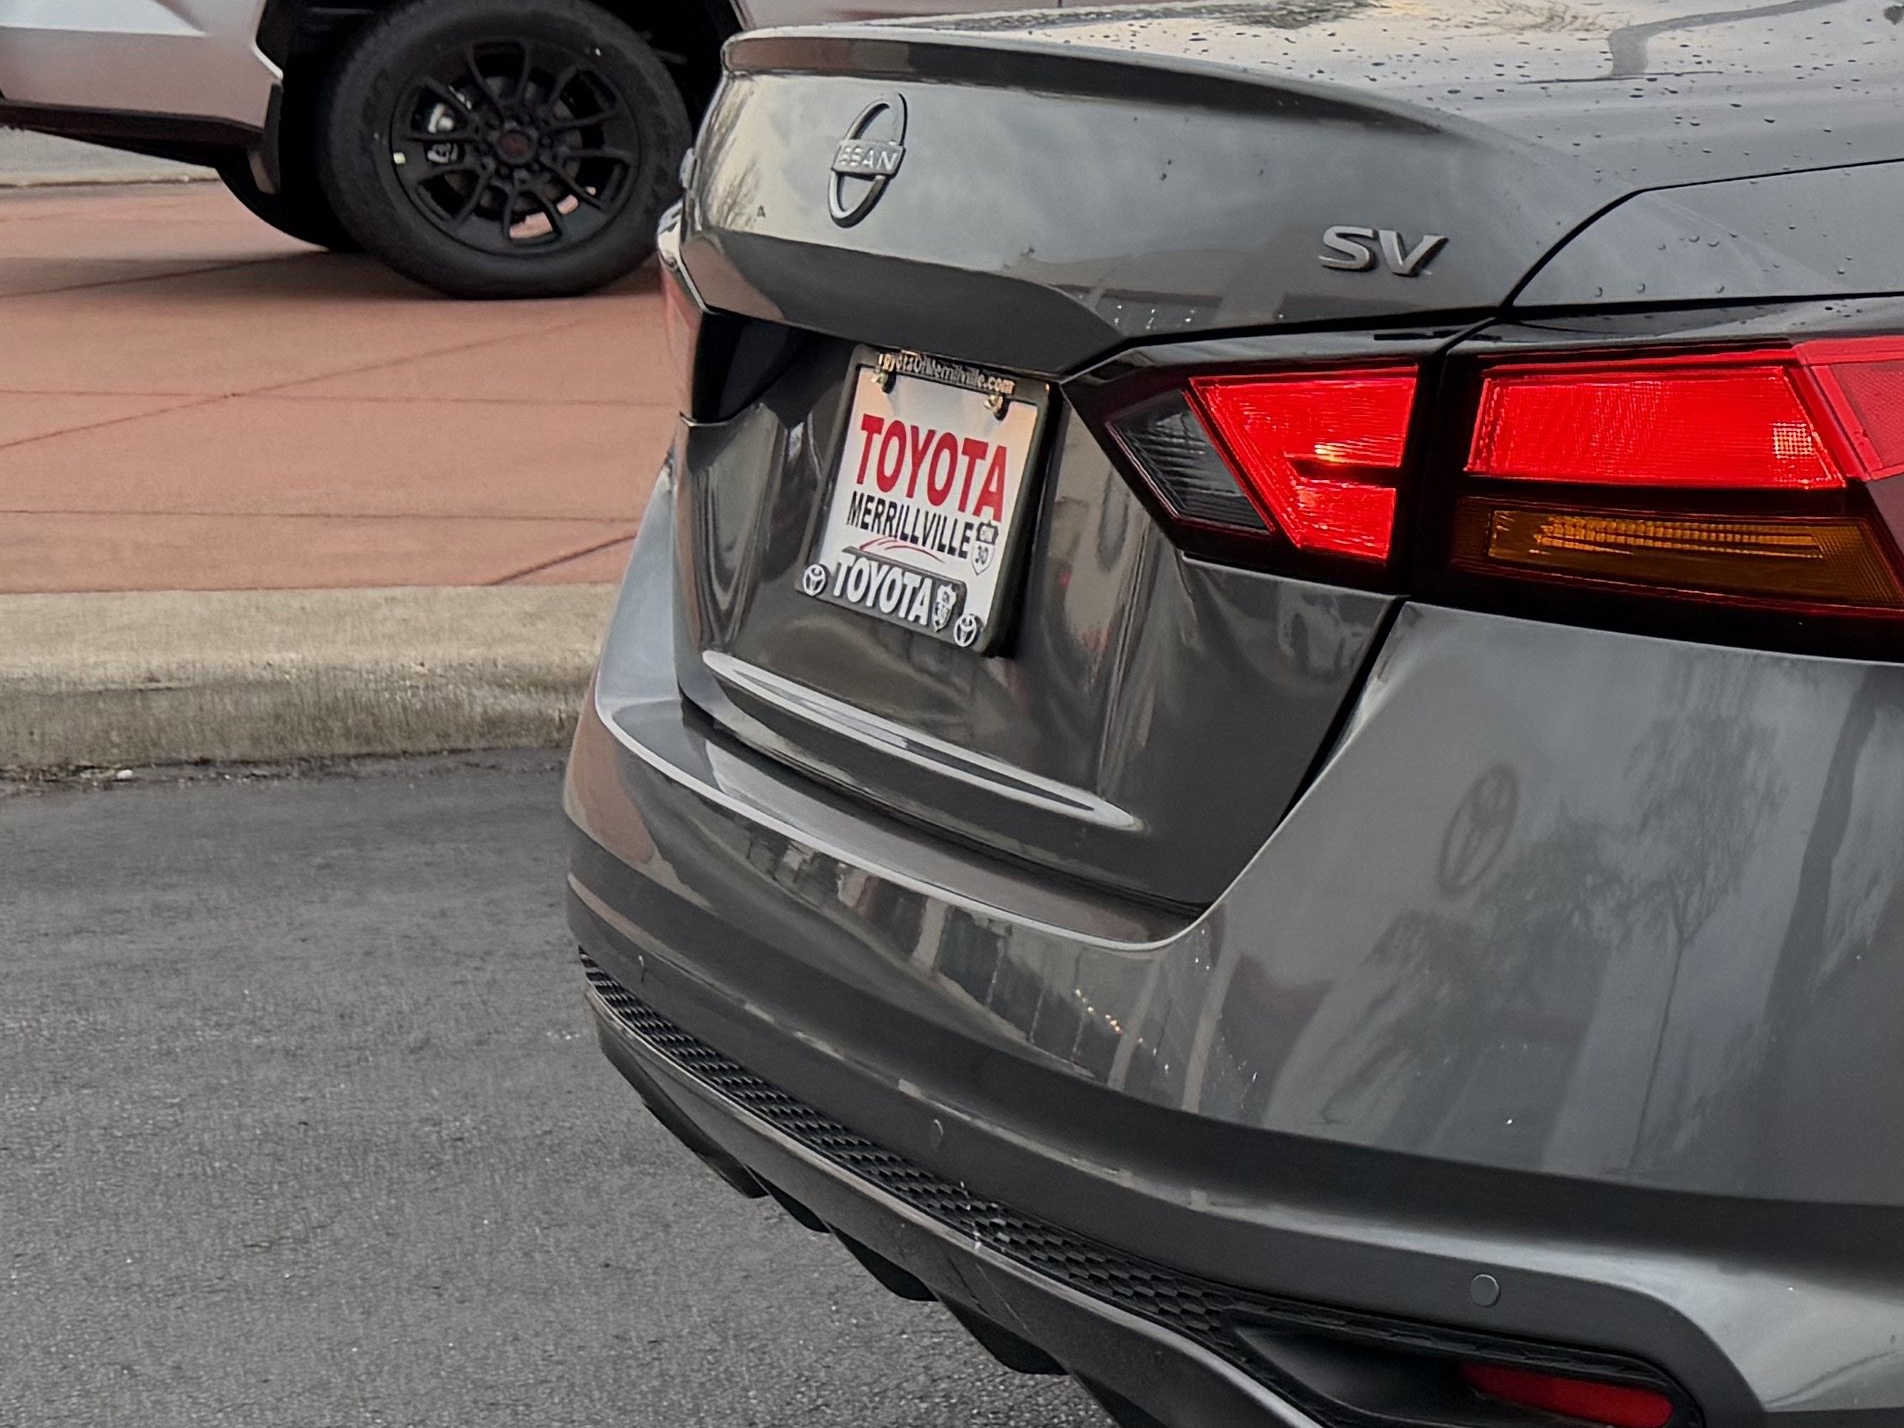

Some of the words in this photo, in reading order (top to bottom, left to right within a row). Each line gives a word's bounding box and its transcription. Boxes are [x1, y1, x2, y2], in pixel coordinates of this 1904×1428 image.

[1318, 225, 1448, 277] SV
[856, 413, 1008, 523] TOYOTA
[845, 490, 974, 560] MERRILLVILLE
[832, 549, 934, 627] TOYOTA
